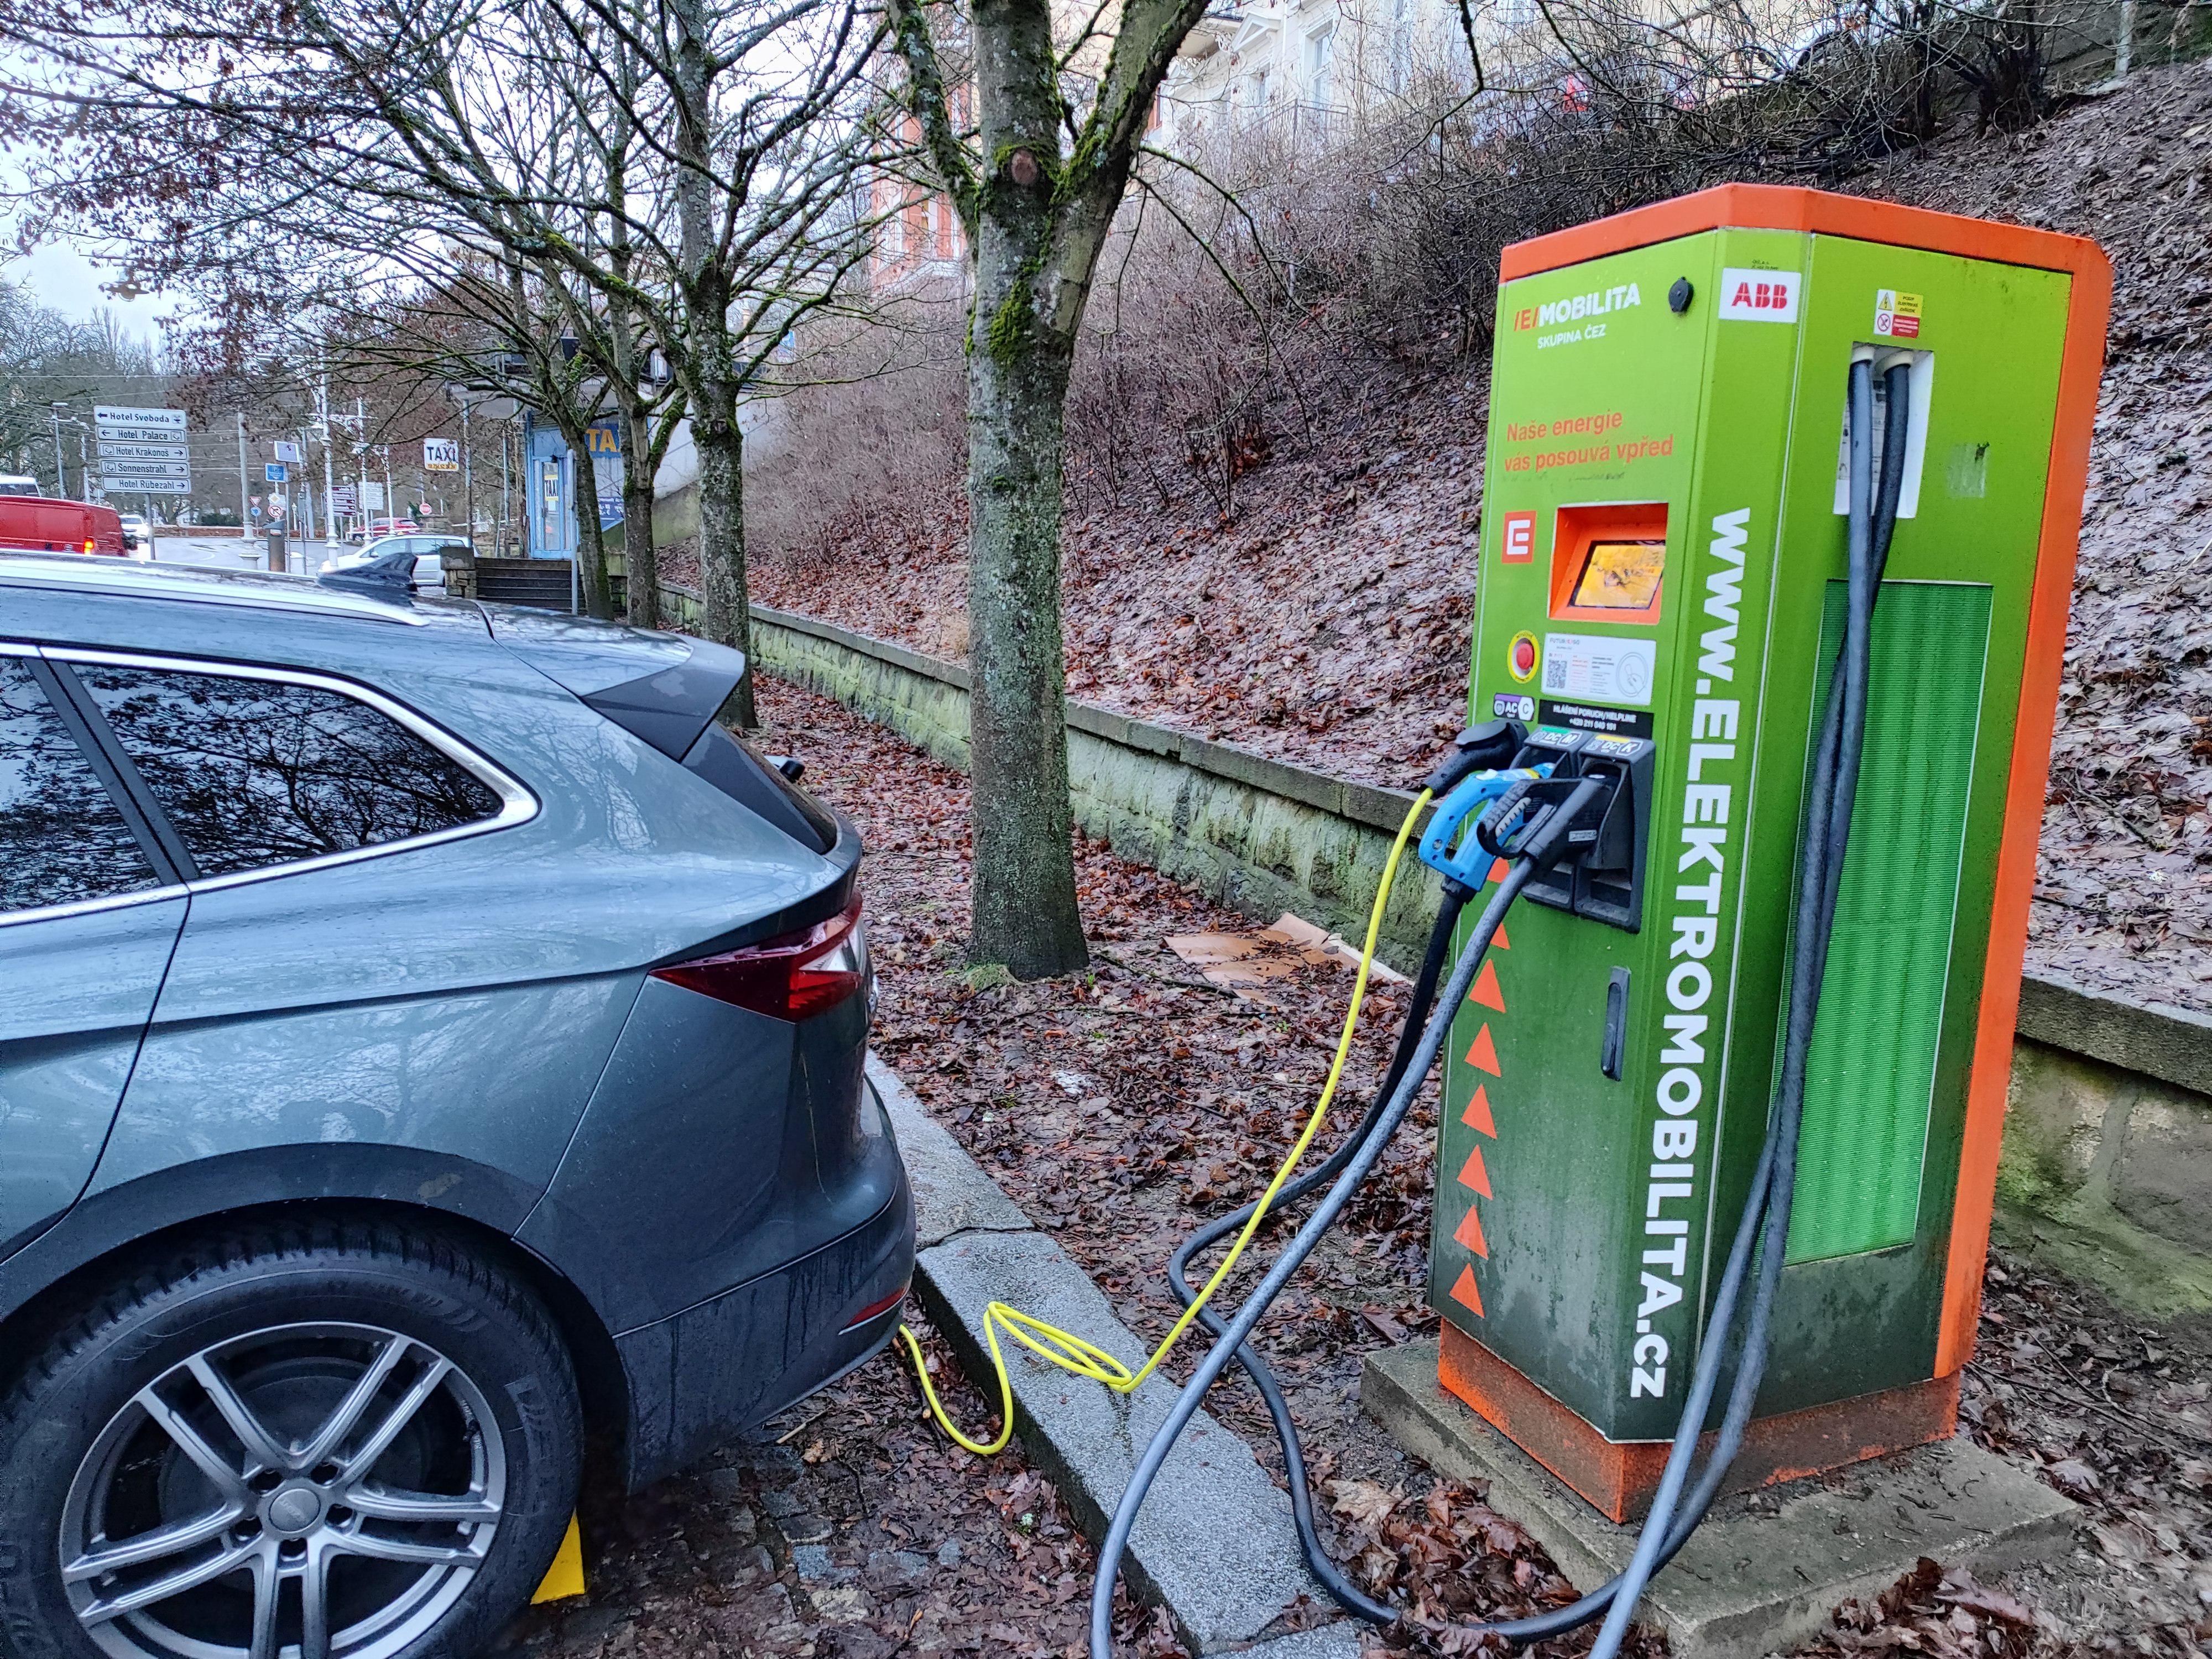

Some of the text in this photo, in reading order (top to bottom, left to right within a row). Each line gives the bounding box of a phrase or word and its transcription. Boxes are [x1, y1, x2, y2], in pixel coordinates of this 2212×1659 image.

[1731, 281, 1787, 309] ABB
[1537, 324, 1606, 349] SKUPINA ČEZ
[110, 412, 169, 422] Hotel Svoboda
[1507, 408, 1623, 442] Naše energie
[118, 430, 168, 440] Hotel Palace
[586, 429, 620, 452] TA
[116, 446, 134, 455] Hotel
[426, 446, 456, 462] TAXI
[1505, 433, 1674, 473] vás posouvá vpřed
[118, 463, 166, 473] Sonnenstrahl
[119, 479, 174, 489] Hotel Rübezahl
[1505, 702, 1529, 714] AC C
[1545, 732, 1562, 741] DC
[1601, 742, 1621, 750] DC
